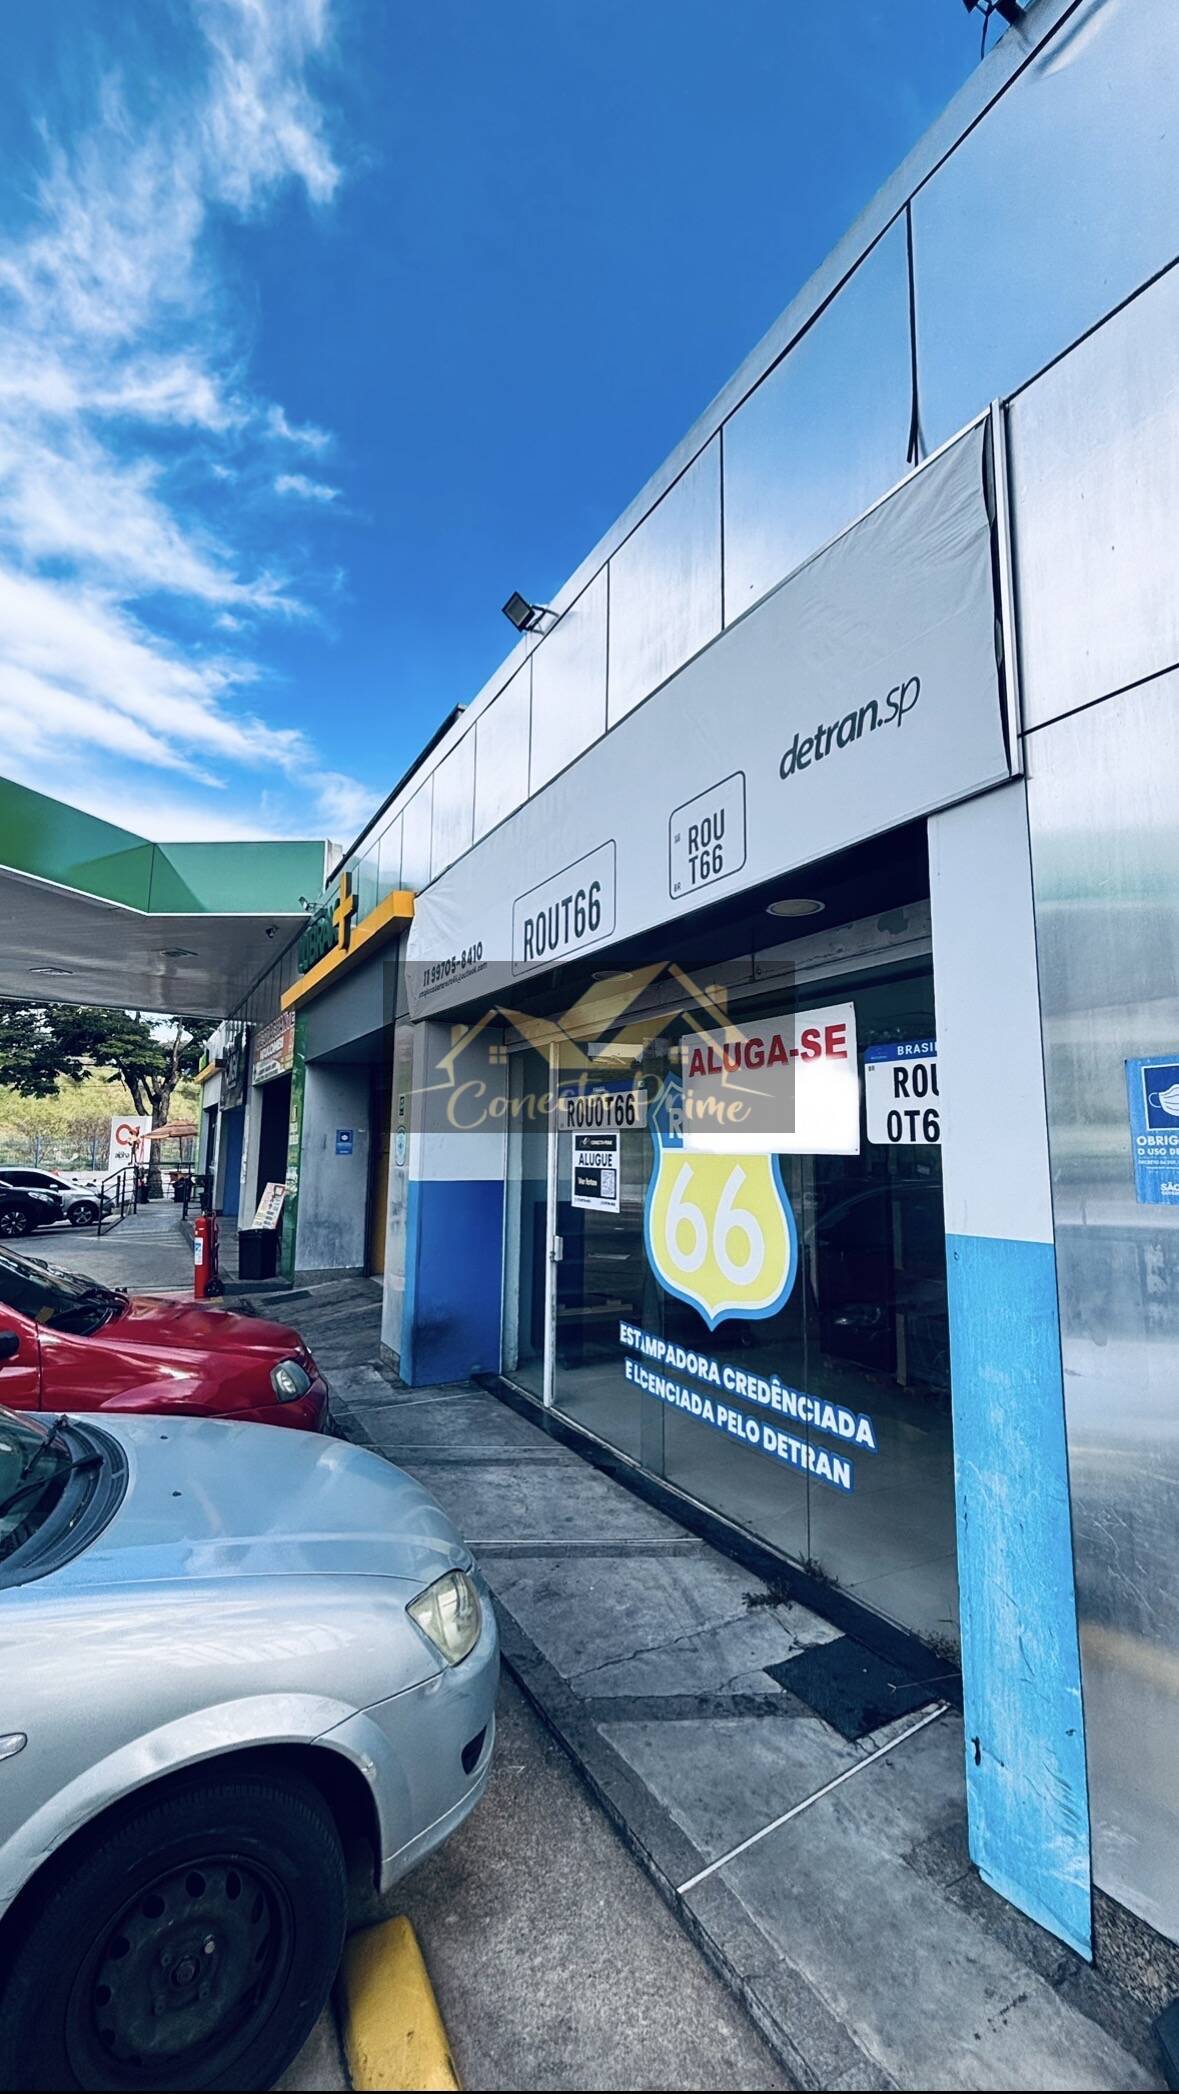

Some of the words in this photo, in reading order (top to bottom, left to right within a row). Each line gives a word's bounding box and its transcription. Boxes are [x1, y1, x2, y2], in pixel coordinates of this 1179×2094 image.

[779, 676, 921, 780] detran.sp
[688, 808, 725, 855] ROU
[688, 843, 724, 885] T66
[523, 880, 601, 962] ROUT66
[688, 1023, 848, 1078] ALUGA-SE
[578, 1153, 612, 1167] ALUGUE
[1147, 1148, 1167, 1156] USO
[665, 1162, 765, 1286] 66
[625, 1360, 633, 1380] E
[717, 1404, 760, 1444] PELO
[762, 1426, 851, 1489] DETRAN
[723, 1367, 875, 1449] CREDÊNCIADA
